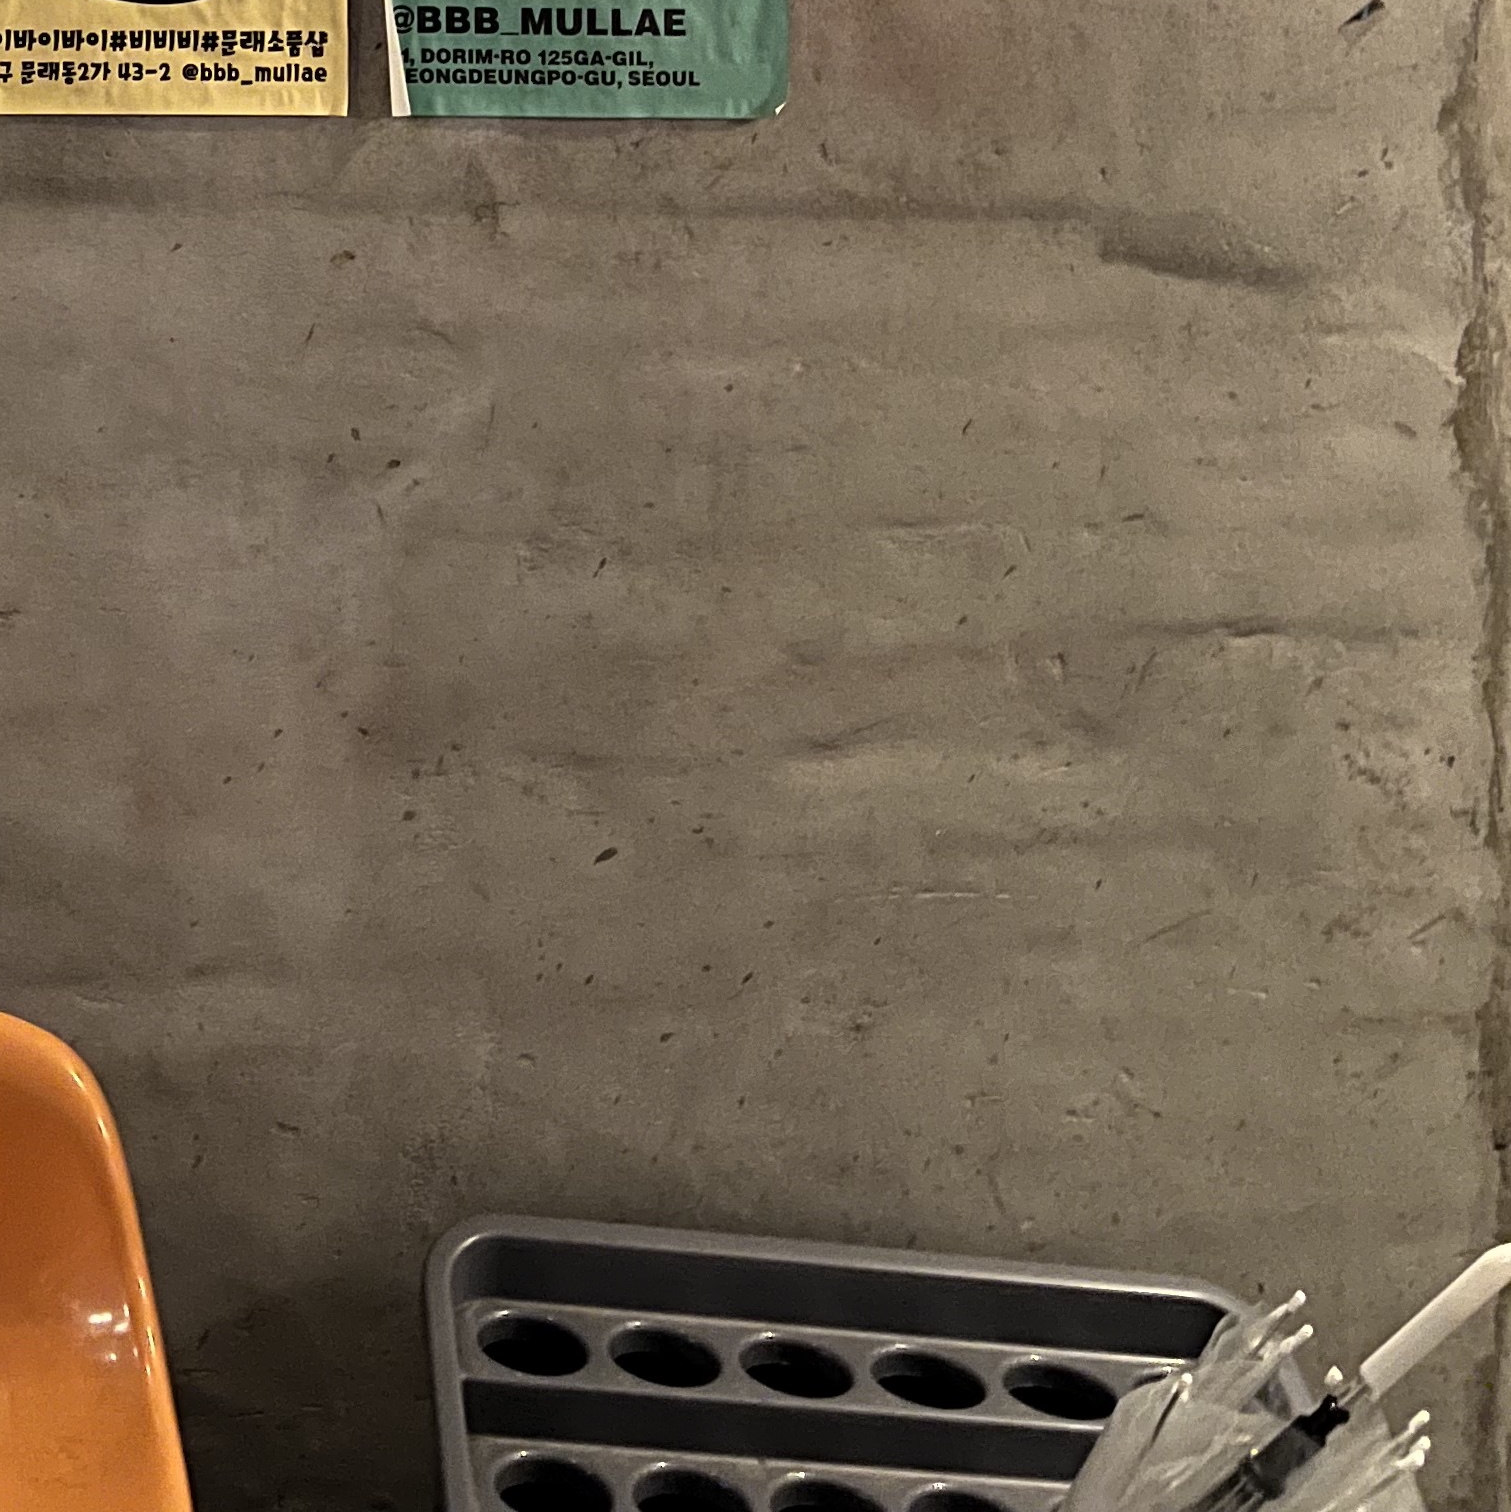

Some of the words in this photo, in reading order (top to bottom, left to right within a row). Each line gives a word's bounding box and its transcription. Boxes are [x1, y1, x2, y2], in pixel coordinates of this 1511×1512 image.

[392, 5, 687, 36] @BBB_MULLAE
[420, 49, 531, 65] DORIM-RO
[538, 50, 654, 70] 125GA-GIL,
[20, 61, 111, 85] 문래동2가
[118, 62, 171, 82] 43-2
[182, 63, 328, 85] @bbb_mullae
[405, 68, 622, 89] EONGDEUNGPO-GU,
[628, 70, 701, 86] SEOUL
